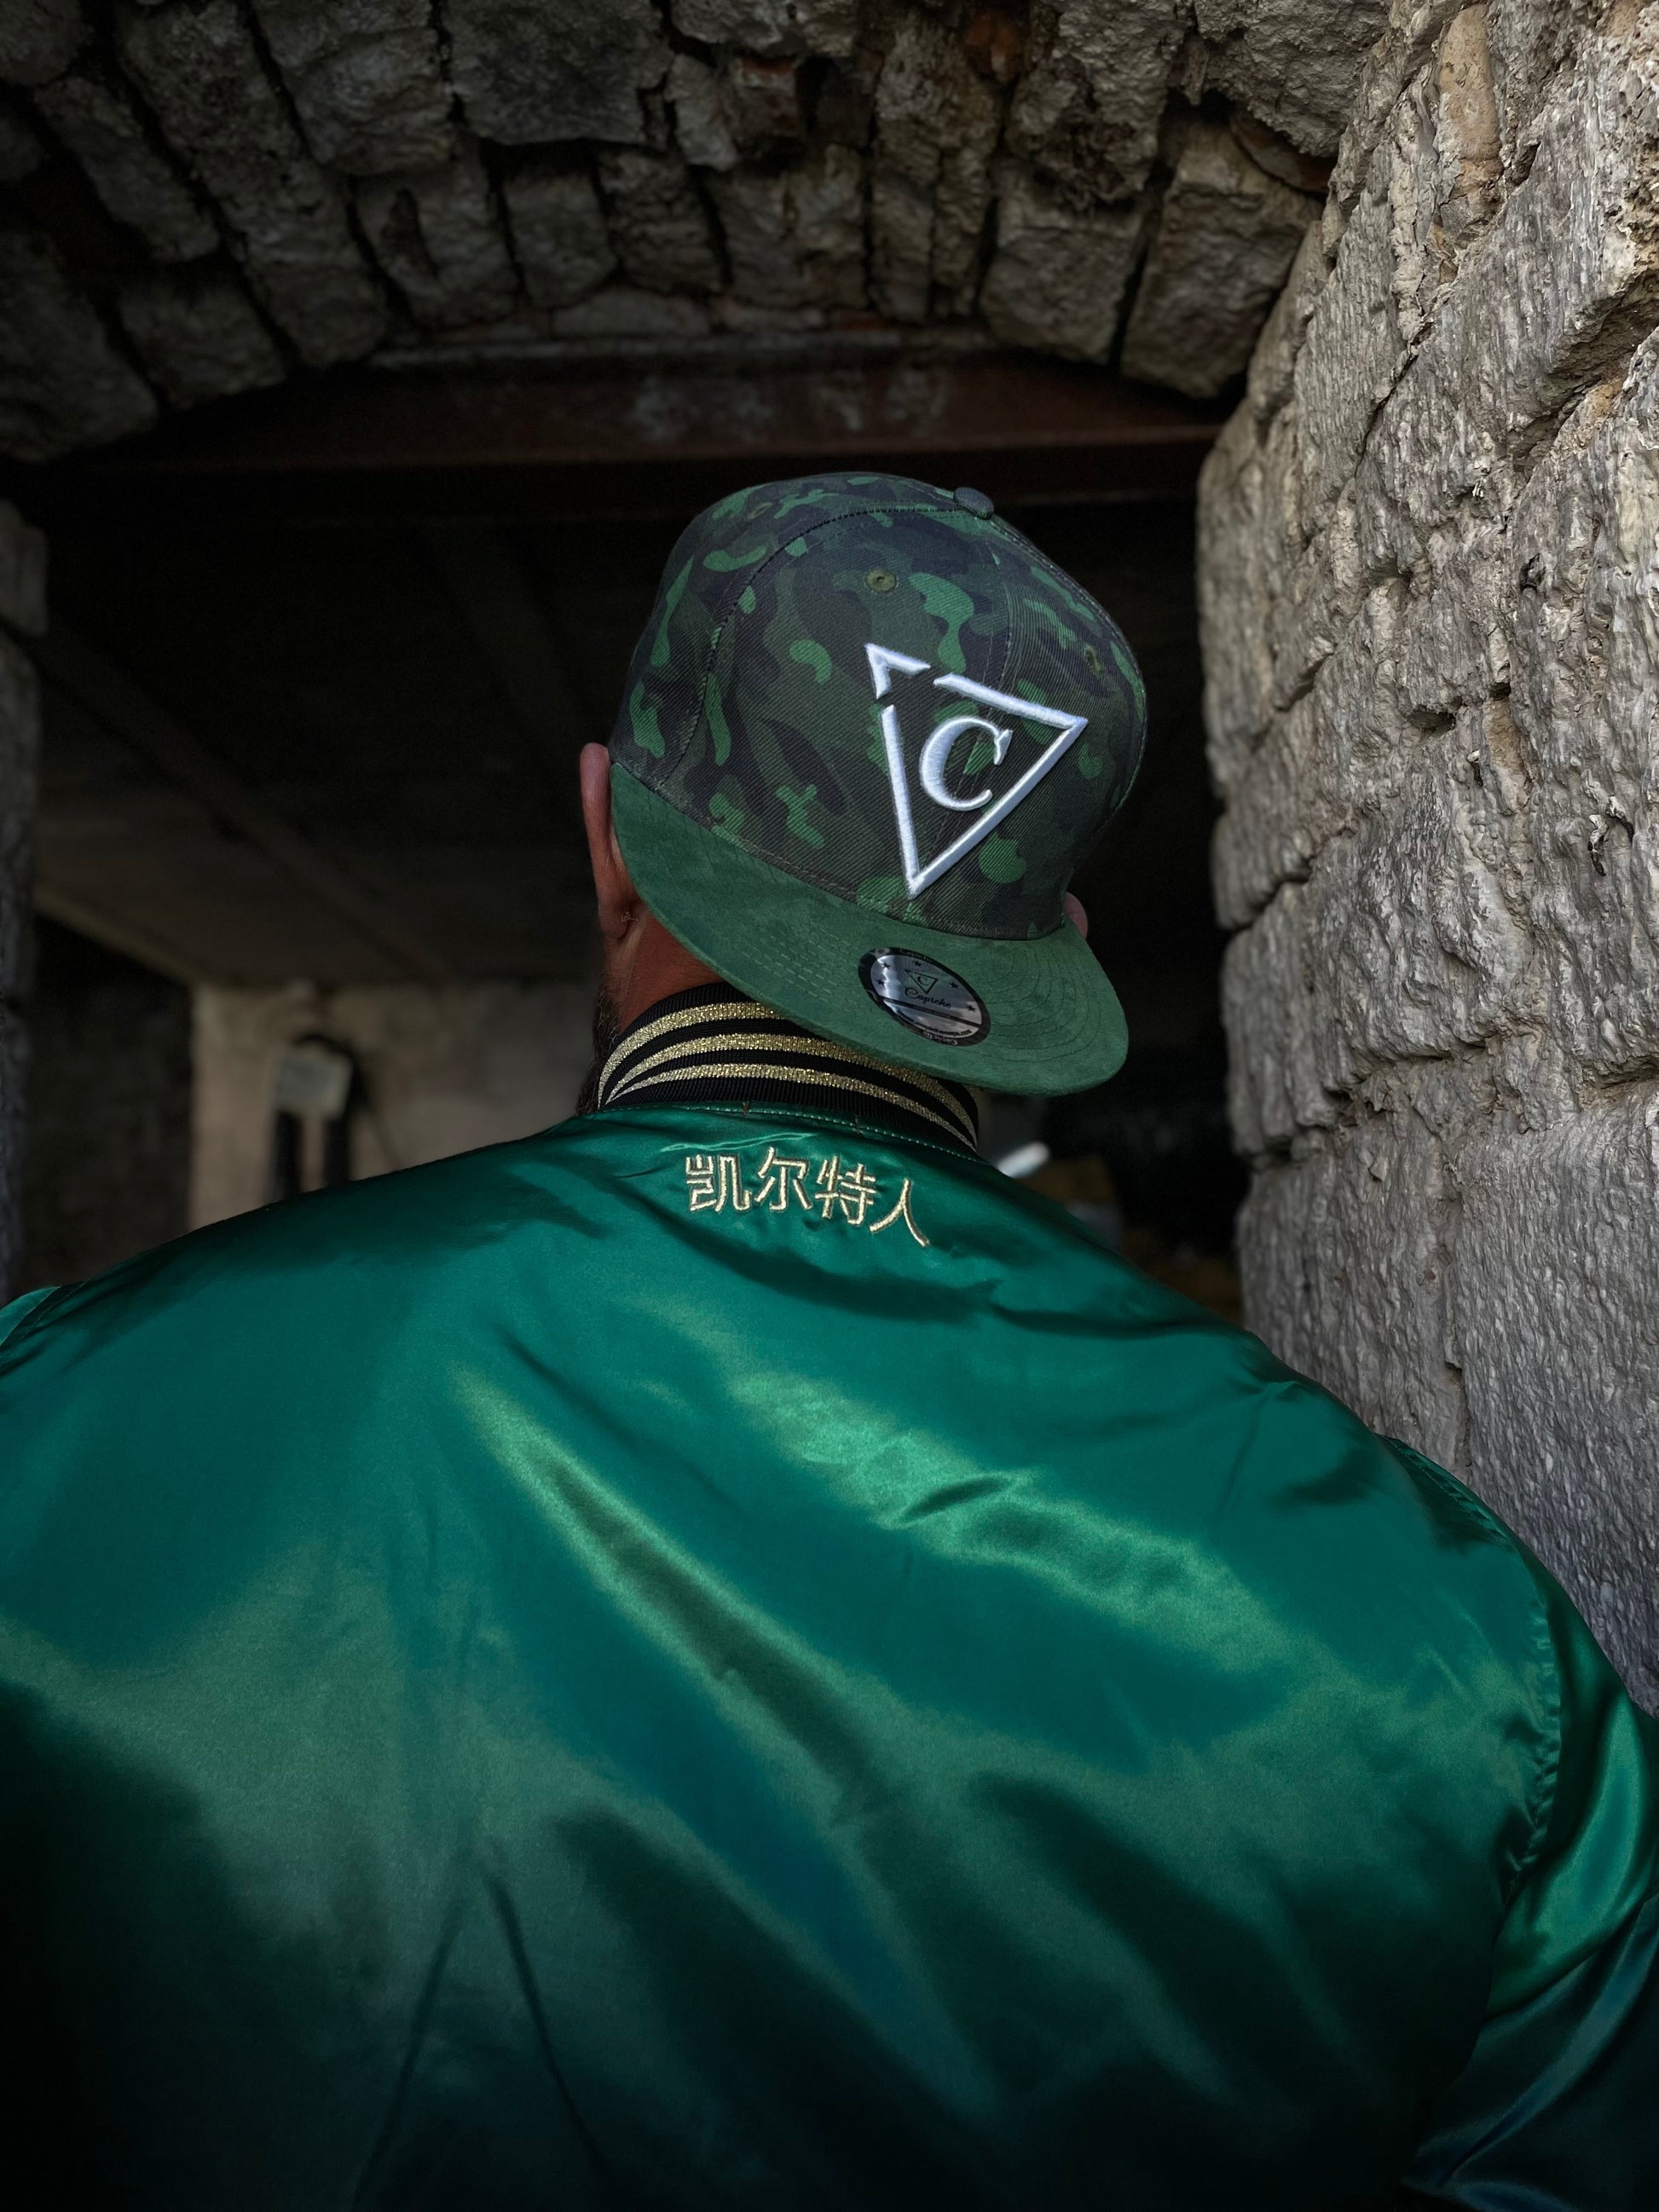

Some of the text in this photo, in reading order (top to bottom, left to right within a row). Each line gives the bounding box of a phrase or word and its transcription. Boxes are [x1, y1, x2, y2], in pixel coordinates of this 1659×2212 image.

[920, 716, 1013, 811] C
[685, 1146, 930, 1247] 凯尔特人
